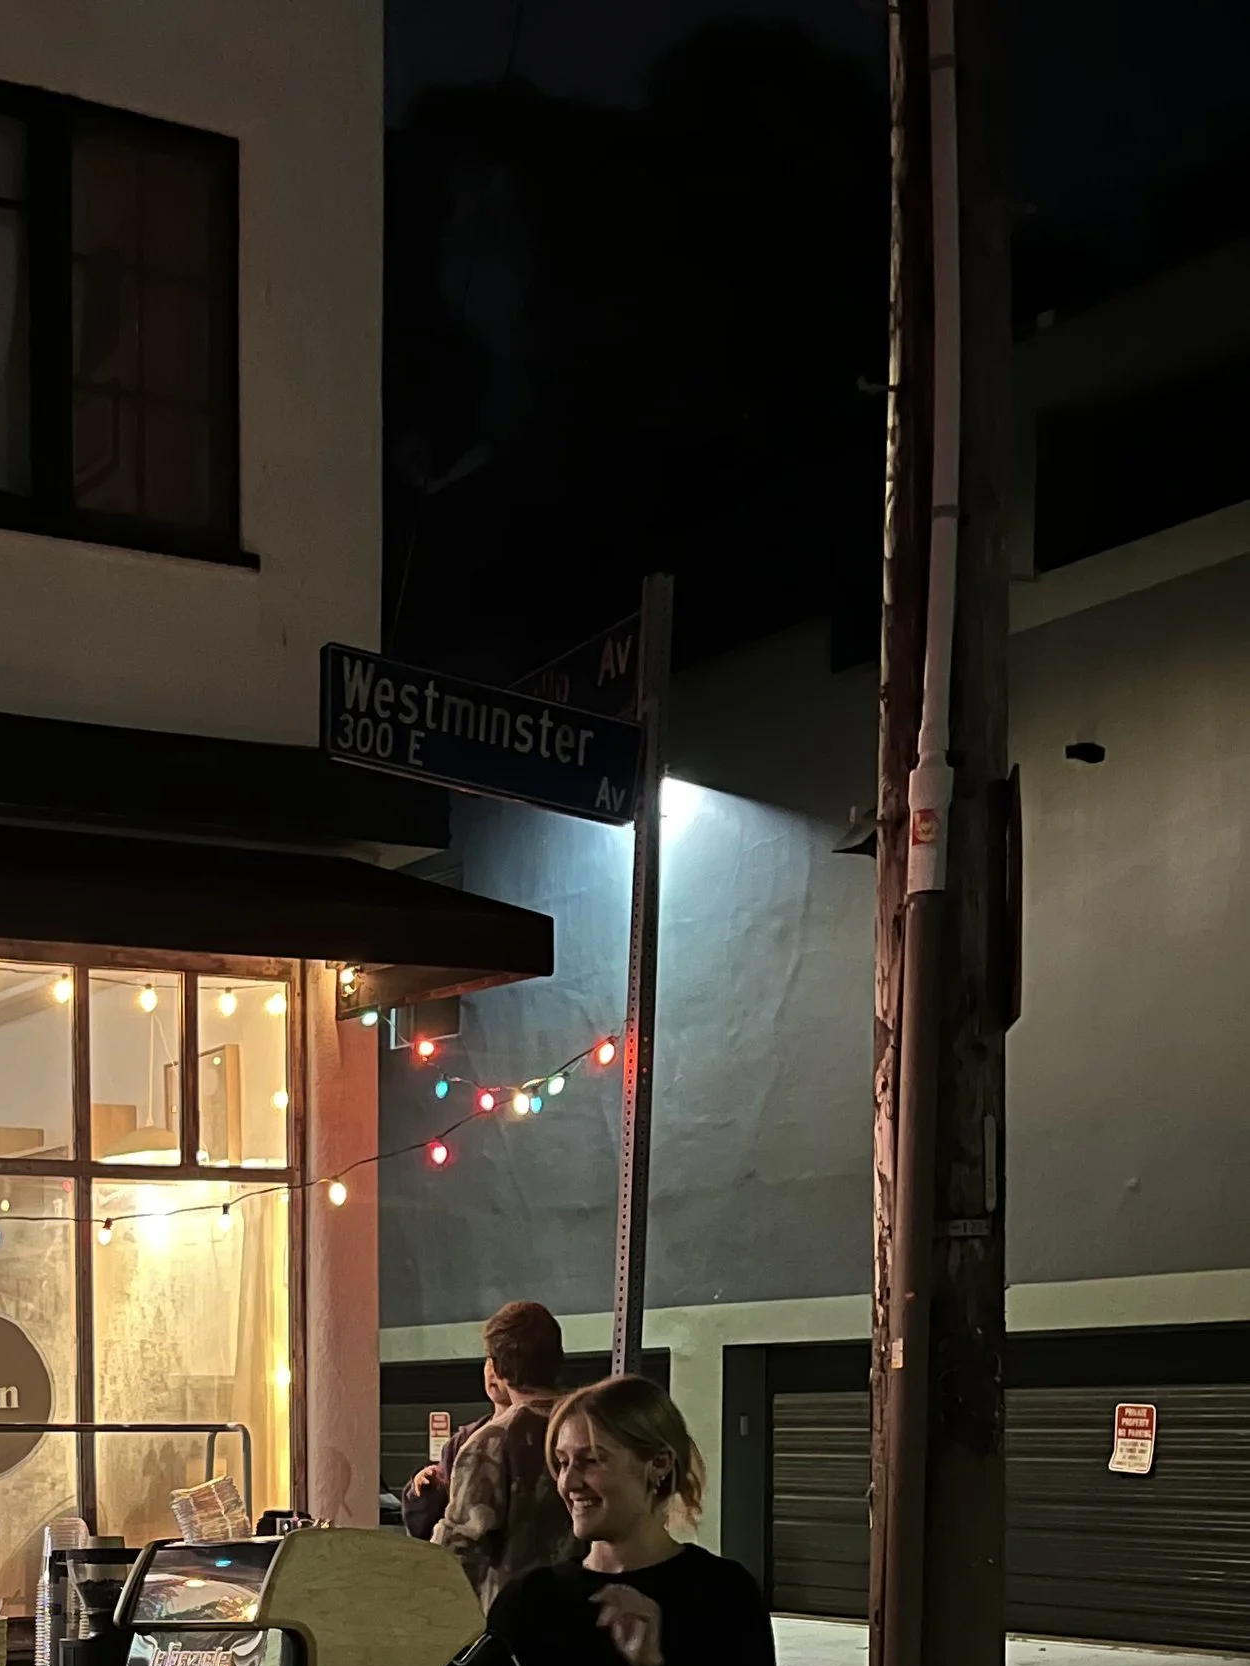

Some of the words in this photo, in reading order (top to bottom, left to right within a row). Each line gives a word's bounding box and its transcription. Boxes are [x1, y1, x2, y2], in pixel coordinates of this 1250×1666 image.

[337, 712, 394, 758] 300
[408, 729, 426, 767] E
[342, 655, 595, 767] Westminster
